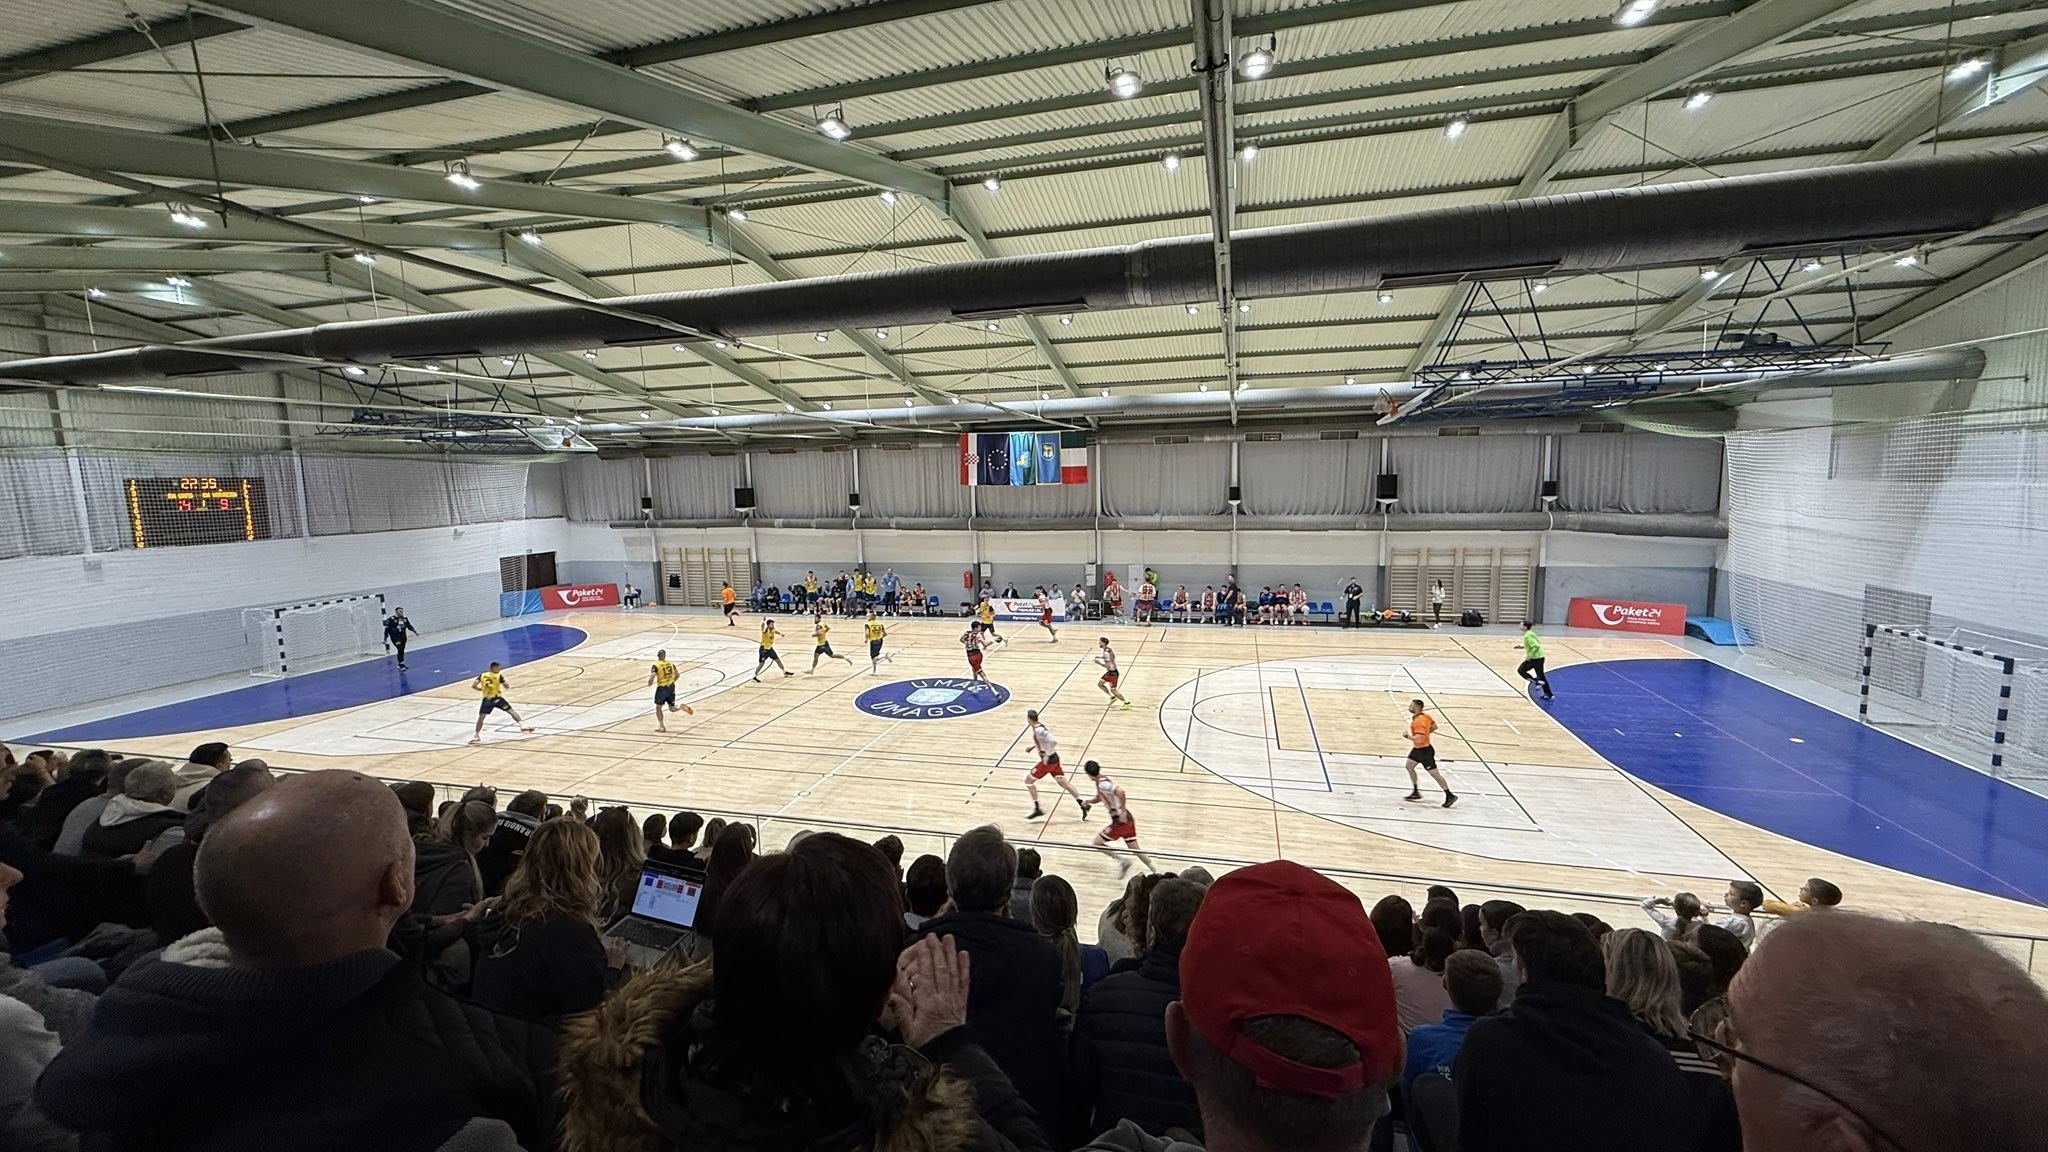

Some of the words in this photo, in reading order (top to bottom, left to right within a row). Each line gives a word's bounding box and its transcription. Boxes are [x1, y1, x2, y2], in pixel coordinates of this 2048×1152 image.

[1612, 605, 1662, 617] Paket24
[662, 665, 673, 677] 13
[870, 701, 967, 717] UMAGO
